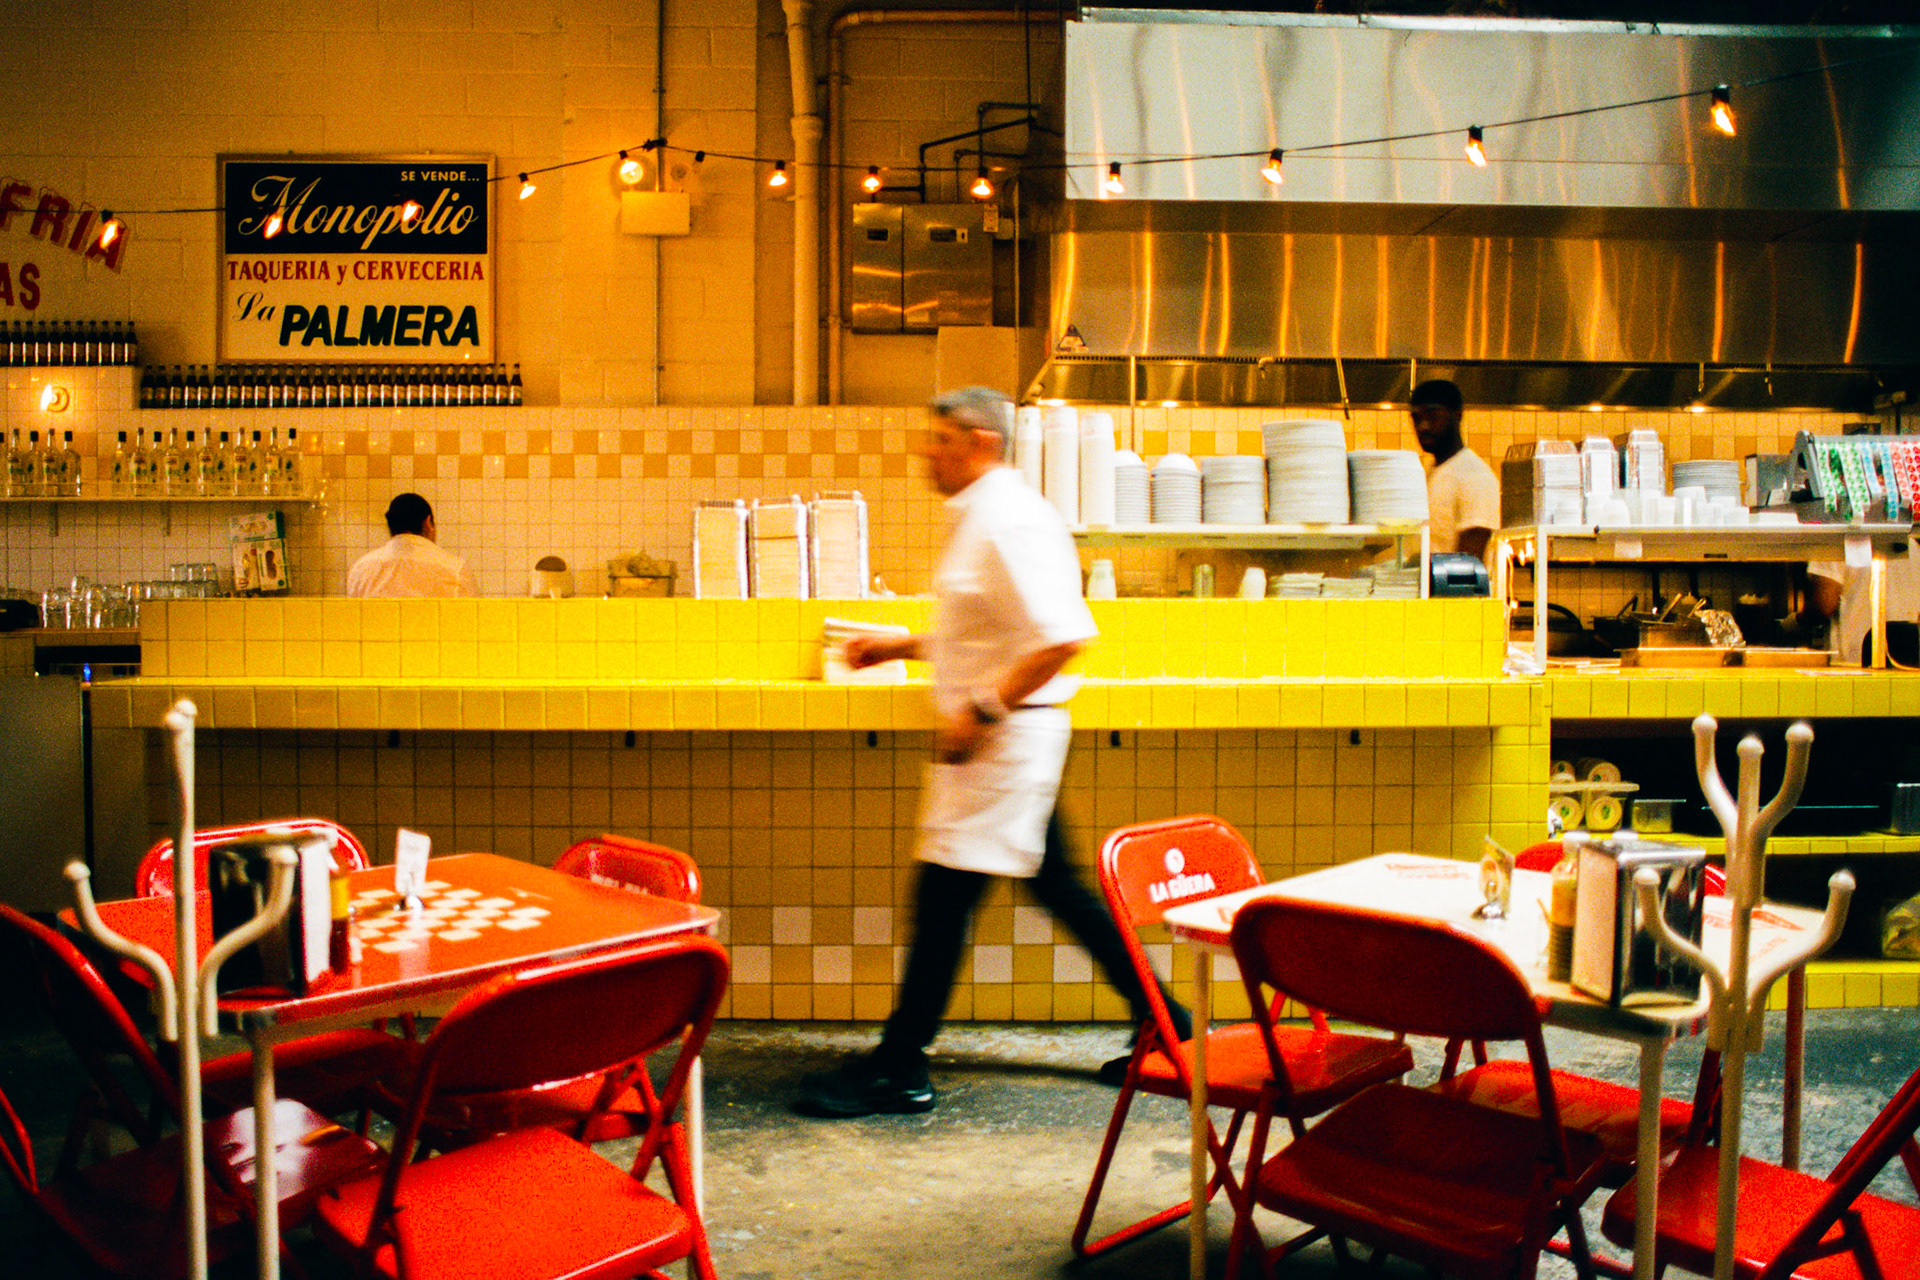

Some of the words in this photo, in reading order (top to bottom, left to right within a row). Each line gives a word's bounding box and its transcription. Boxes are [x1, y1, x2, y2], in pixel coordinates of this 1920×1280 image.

[400, 171, 416, 182] SE
[421, 171, 480, 182] VENDE...
[0, 180, 127, 271] FRIA
[238, 174, 480, 250] Monopolio
[227, 260, 330, 282] TAQUERIA
[336, 264, 348, 286] y
[353, 260, 485, 281] CERVECERIA
[232, 291, 277, 322] La
[279, 304, 480, 347] PALMERA
